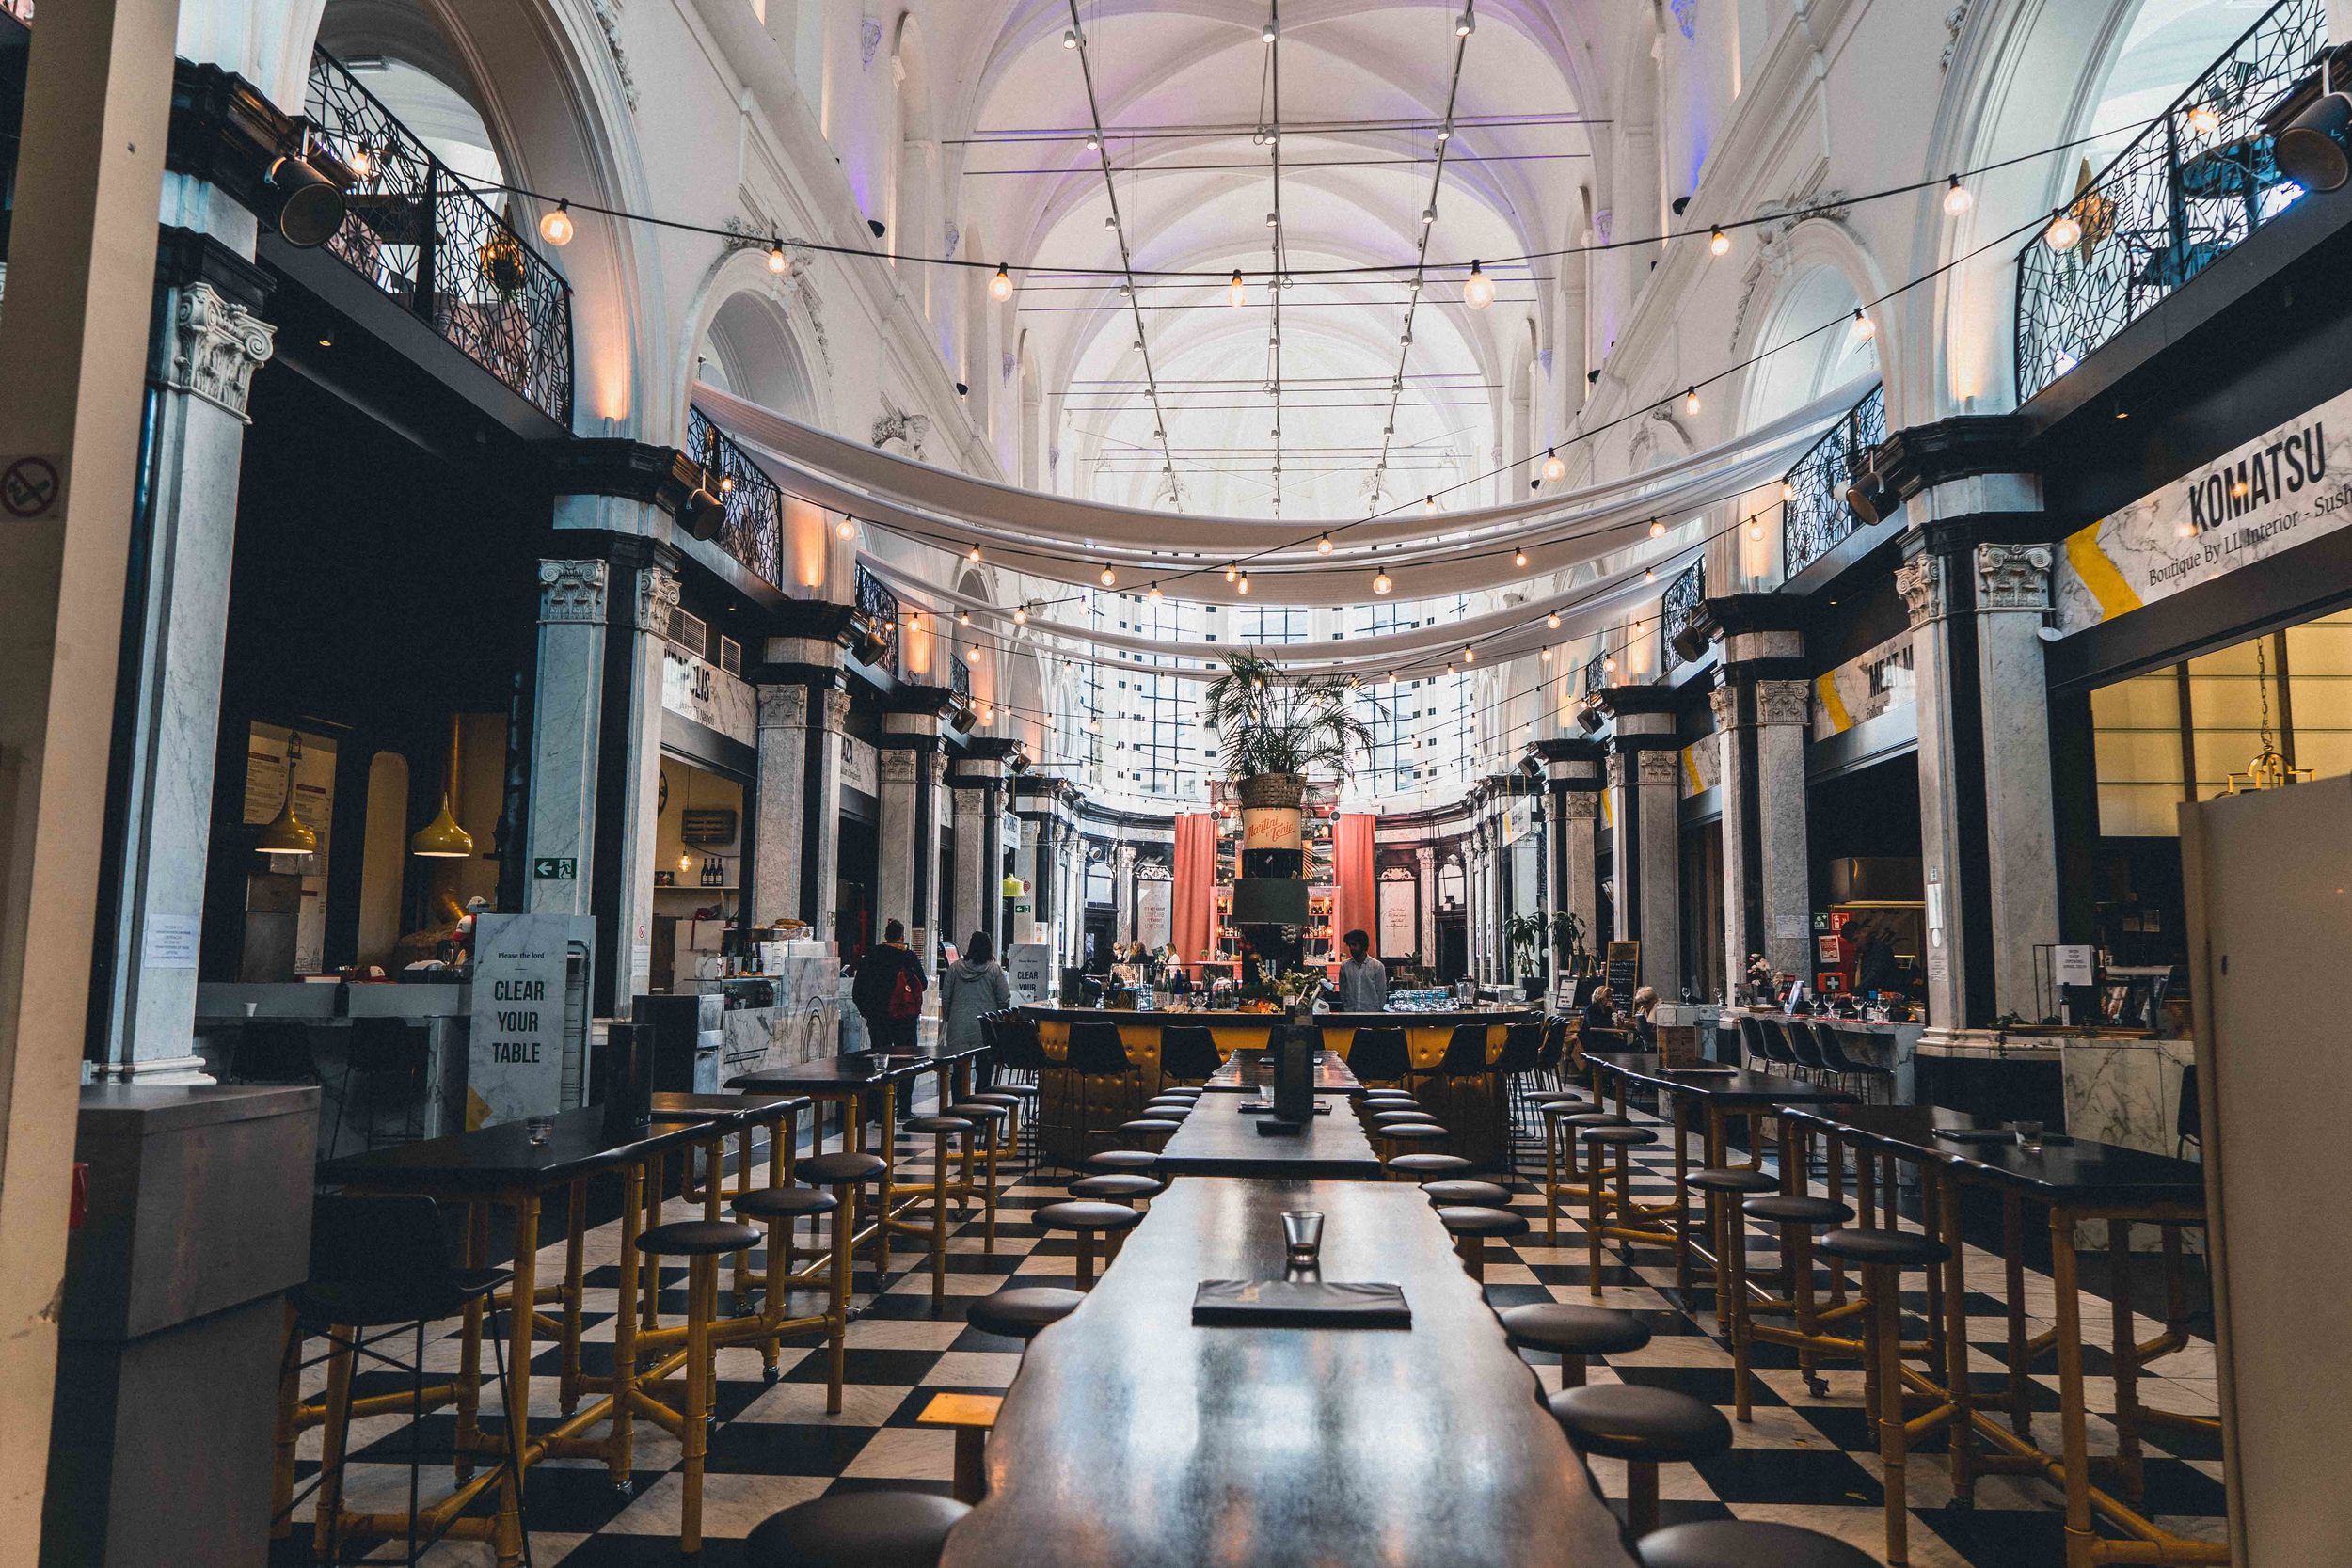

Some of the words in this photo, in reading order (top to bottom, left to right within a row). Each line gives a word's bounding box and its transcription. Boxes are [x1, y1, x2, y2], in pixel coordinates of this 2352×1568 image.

[2189, 421, 2326, 532] KOMATSU
[2149, 553, 2201, 587] Boutique
[2203, 543, 2221, 565] By
[2224, 532, 2242, 555] LL
[2246, 510, 2299, 546] Interior
[1017, 971, 1039, 980] CLEAR
[494, 980, 544, 1001] CLEAR
[497, 1011, 539, 1032] YOUR
[492, 1042, 541, 1064] TABLE
